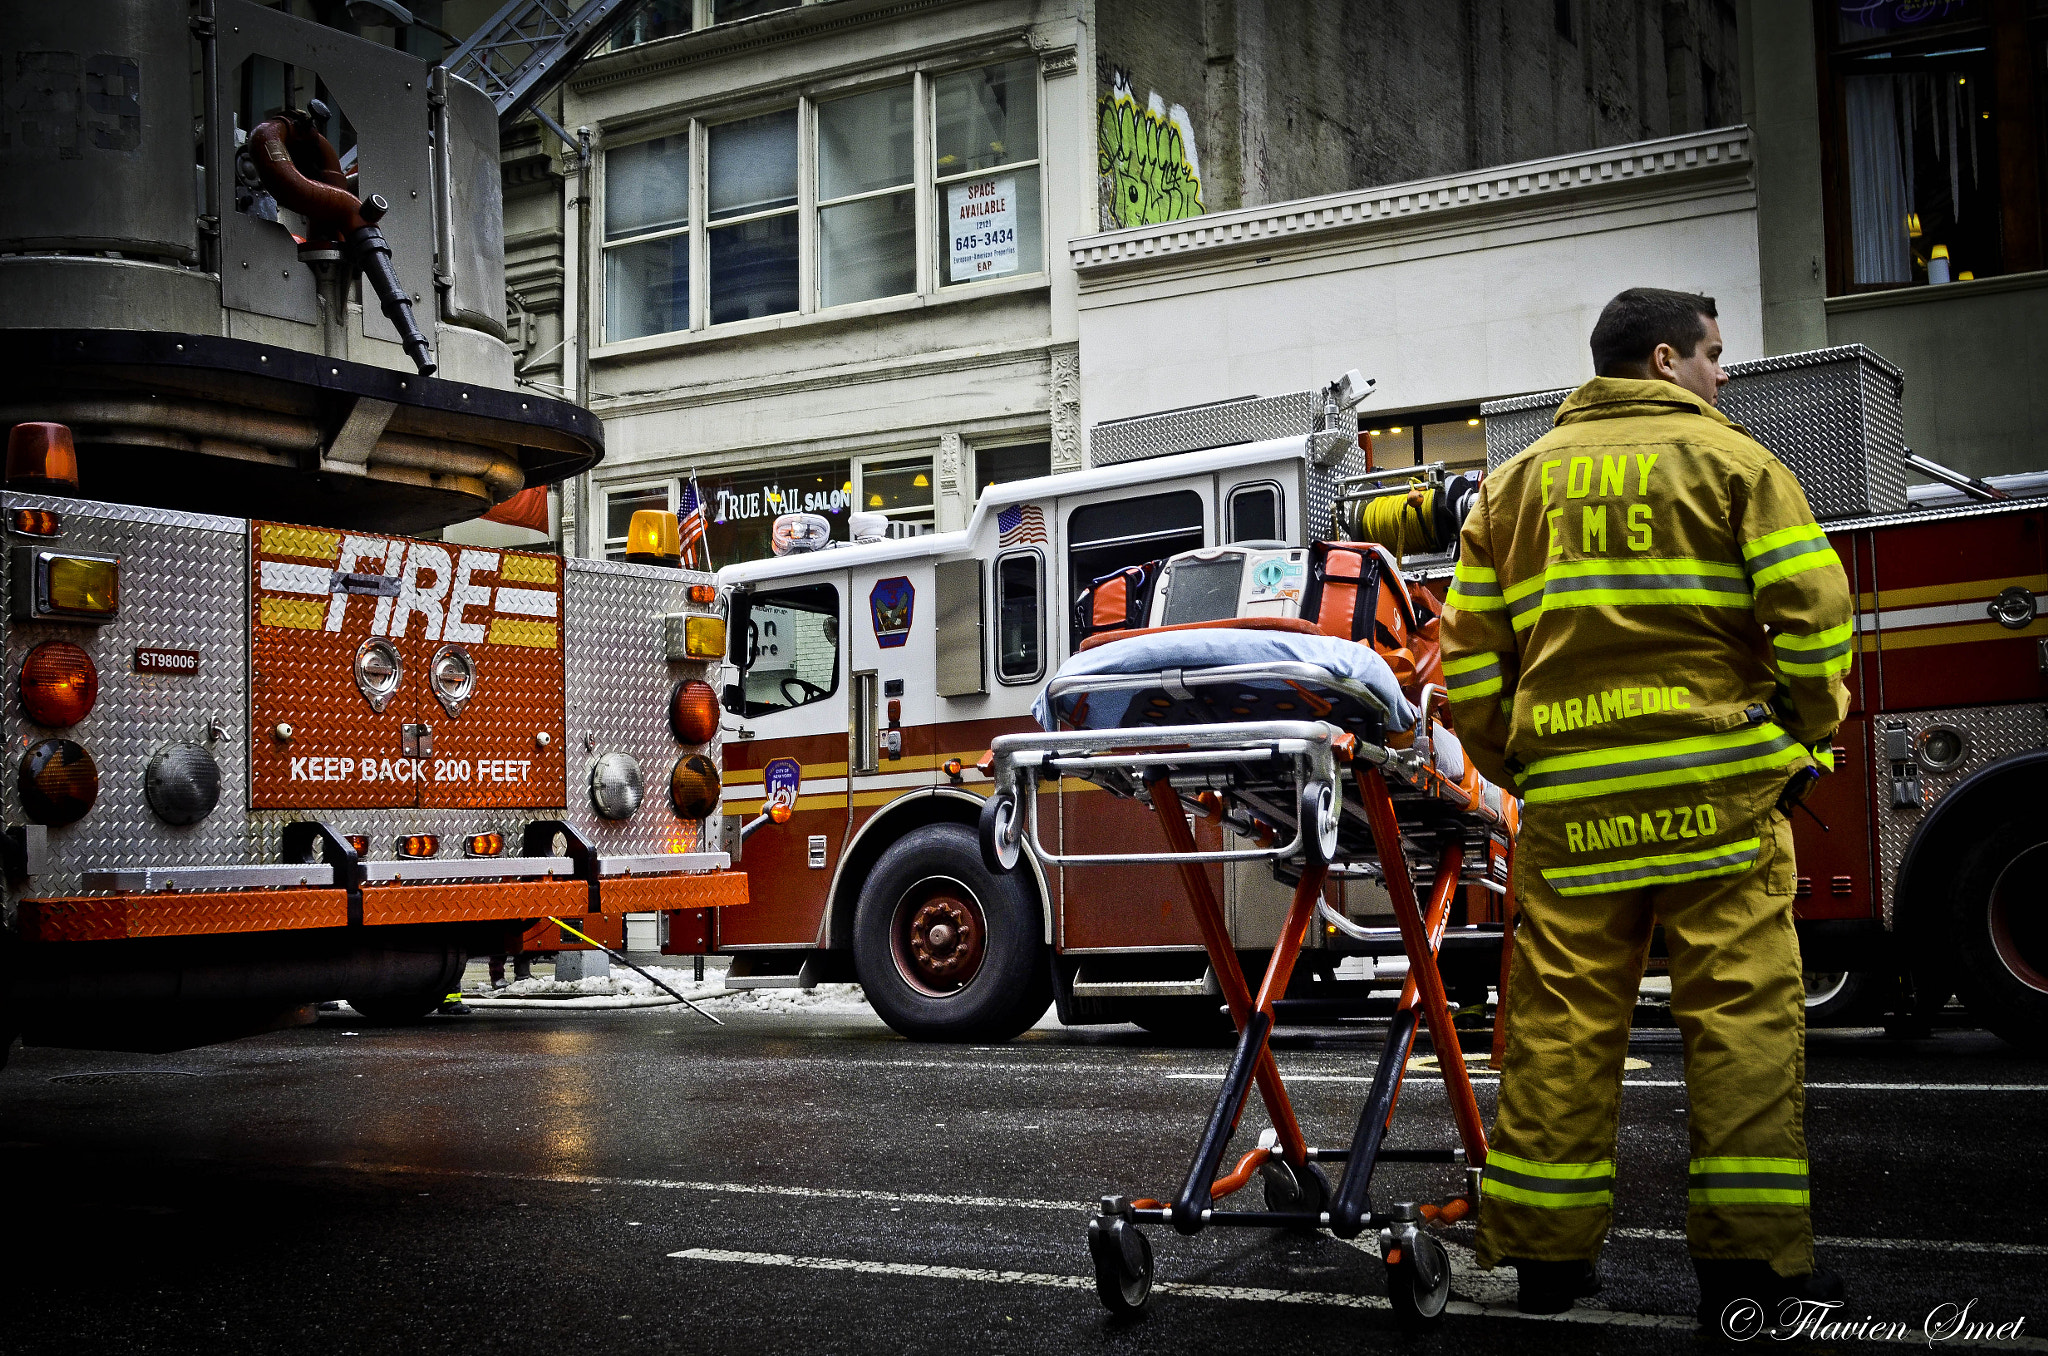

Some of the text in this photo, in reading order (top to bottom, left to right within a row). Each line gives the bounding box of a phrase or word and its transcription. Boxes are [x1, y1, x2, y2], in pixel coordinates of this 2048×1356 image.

[968, 181, 995, 199] SPACE
[960, 198, 1006, 220] AVAILABLE
[956, 228, 1013, 251] 645-3434
[977, 260, 992, 272] EAP
[1540, 453, 1659, 506] FDNY
[717, 490, 760, 520] TRUE
[763, 485, 803, 517] NAIL
[804, 489, 851, 512] SALON
[325, 534, 501, 644] FIRE
[141, 652, 195, 669] ST98006
[1532, 686, 1691, 737] PARAMEDIC
[291, 756, 531, 782] KEEP BACK 200 FEET
[1565, 803, 1718, 853] RANDAZZO
